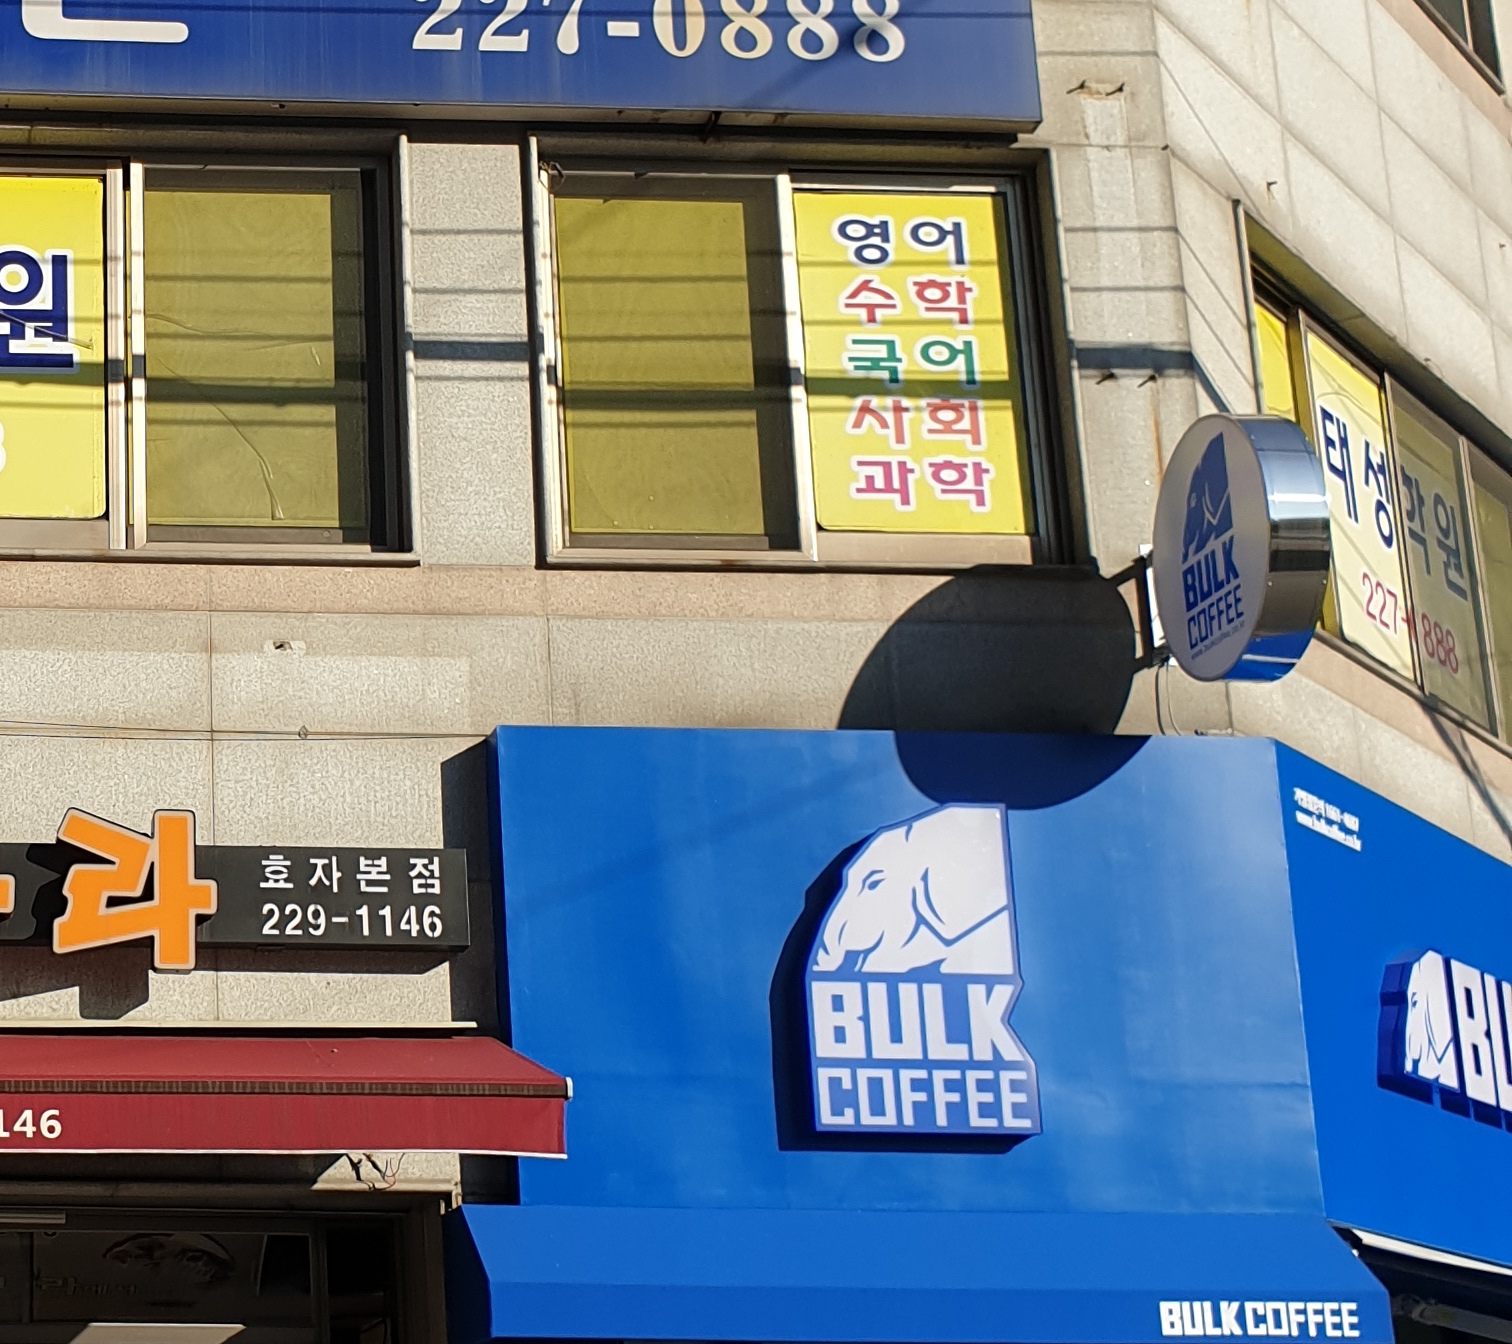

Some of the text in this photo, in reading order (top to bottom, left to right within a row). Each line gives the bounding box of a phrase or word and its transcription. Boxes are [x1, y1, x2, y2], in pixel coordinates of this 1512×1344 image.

[837, 219, 965, 265] 영어
[844, 279, 973, 324] 수학
[848, 339, 976, 385] 국어
[852, 399, 981, 445] 사회
[855, 460, 989, 507] 과학
[1182, 536, 1240, 613] BULK
[1188, 584, 1244, 646] COFFEE
[260, 855, 441, 894] 효자본점
[262, 903, 442, 937] 229-1146
[813, 982, 1022, 1060] BULK
[817, 1066, 1033, 1128] COFFEE
[1159, 1301, 1361, 1338] BULK COFFEE
